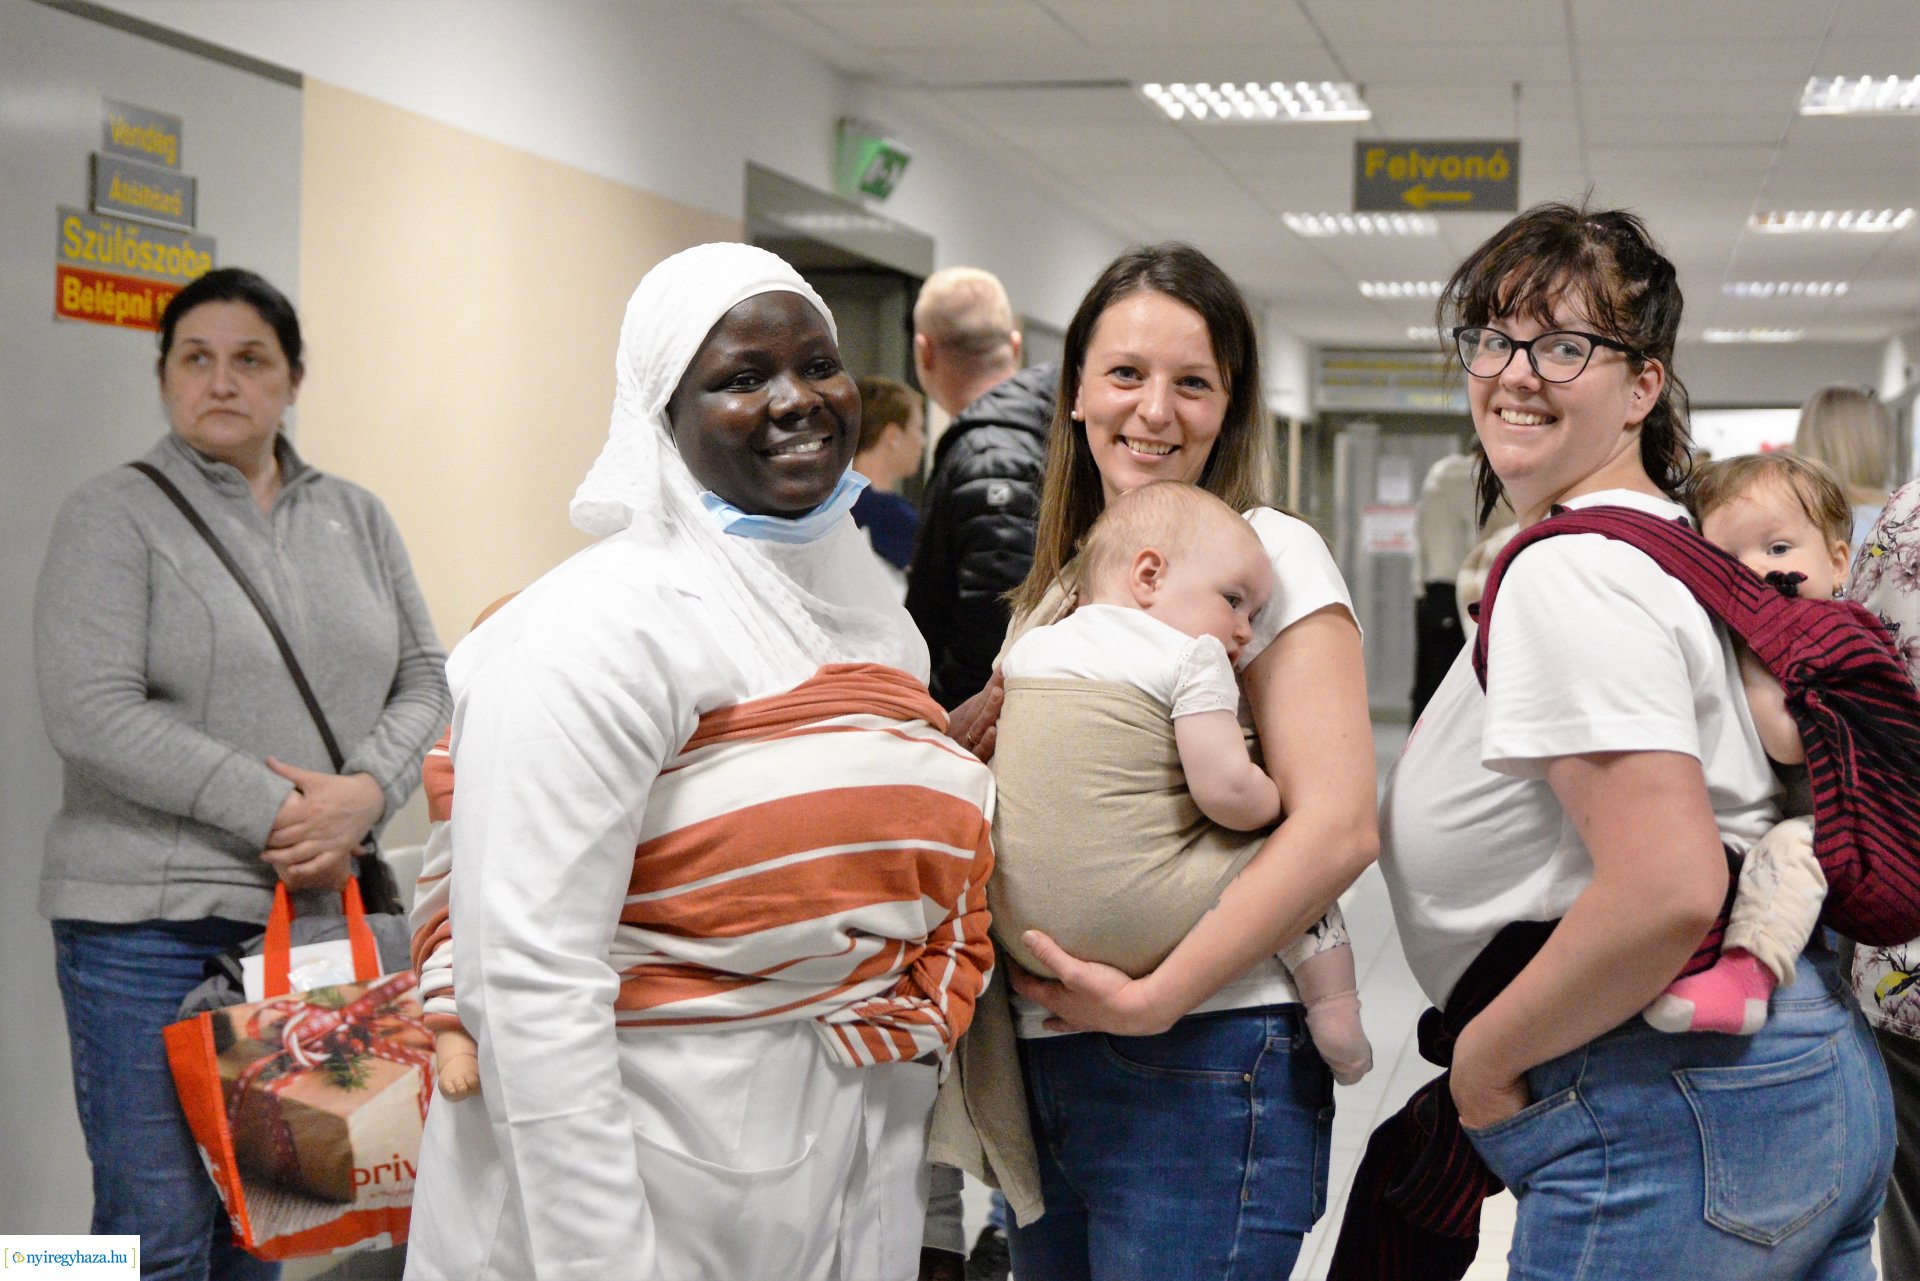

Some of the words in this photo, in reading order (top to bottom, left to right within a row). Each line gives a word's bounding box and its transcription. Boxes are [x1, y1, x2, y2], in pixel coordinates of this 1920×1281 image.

[1364, 148, 1509, 181] Felvonó
[64, 216, 211, 279] Szülőszoba
[63, 276, 152, 324] Belépni
